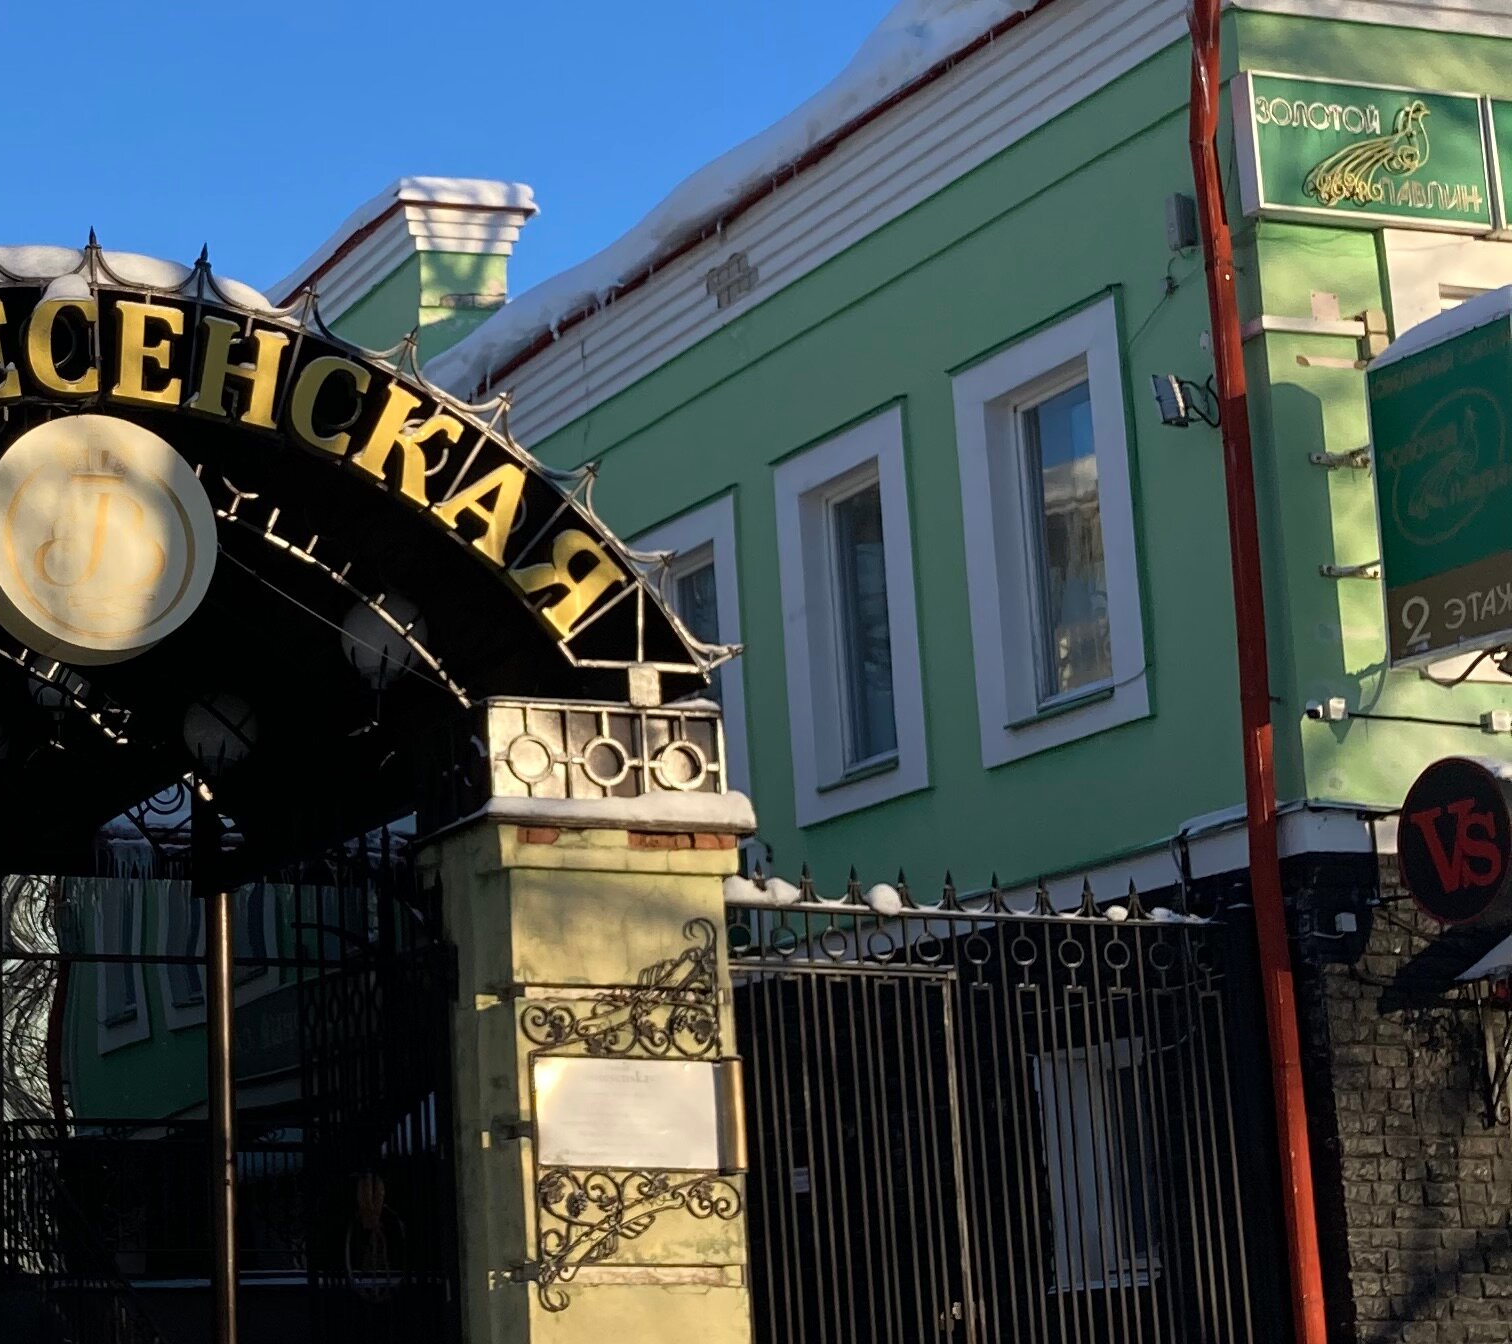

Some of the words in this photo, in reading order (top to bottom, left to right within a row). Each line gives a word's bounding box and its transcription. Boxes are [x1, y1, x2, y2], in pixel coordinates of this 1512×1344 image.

[1255, 95, 1381, 135] ЗОЛОТОЙ
[1379, 176, 1483, 214] ПАВЛИН
[1401, 595, 1432, 647] 2
[1409, 797, 1502, 894] VS
